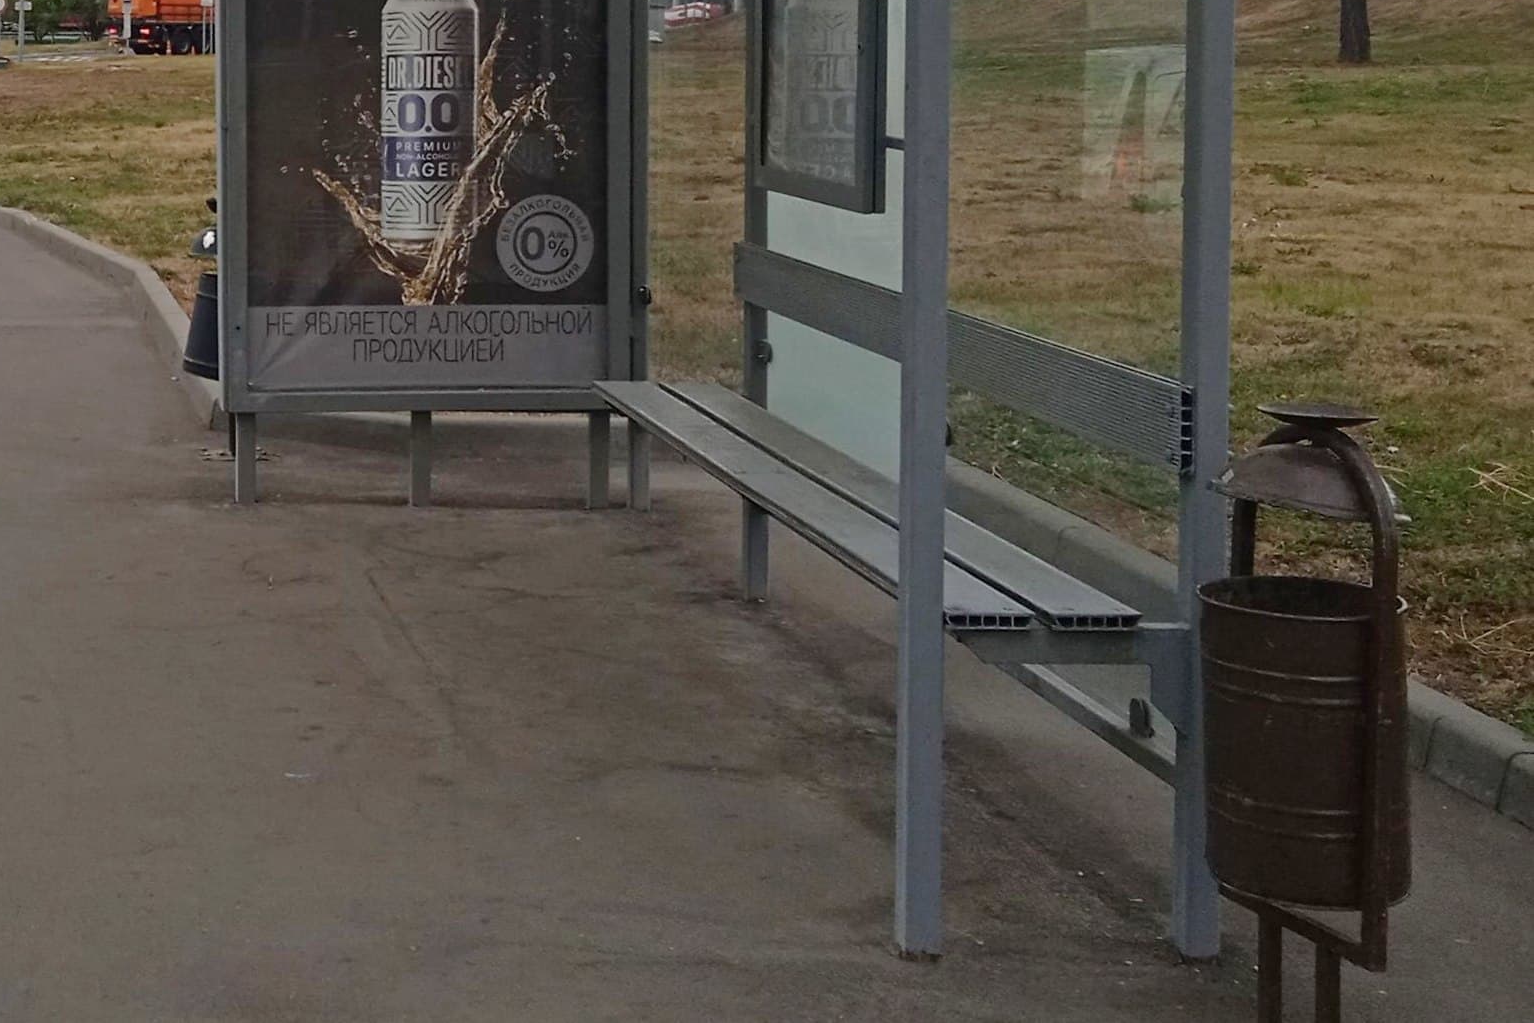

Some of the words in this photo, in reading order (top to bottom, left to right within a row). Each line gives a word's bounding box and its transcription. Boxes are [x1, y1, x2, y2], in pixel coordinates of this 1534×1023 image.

[398, 93, 460, 133] 0.0
[396, 162, 459, 177] LAGER
[509, 263, 580, 288] ПРОДУКЦИЯ
[266, 312, 293, 336] НЕ
[305, 310, 415, 335] ЯВЛЯЕТСЯ
[428, 306, 592, 335] АЛКОГОЛЬНОЙ
[353, 333, 505, 362] ПРОДУКЦИЕЙ
